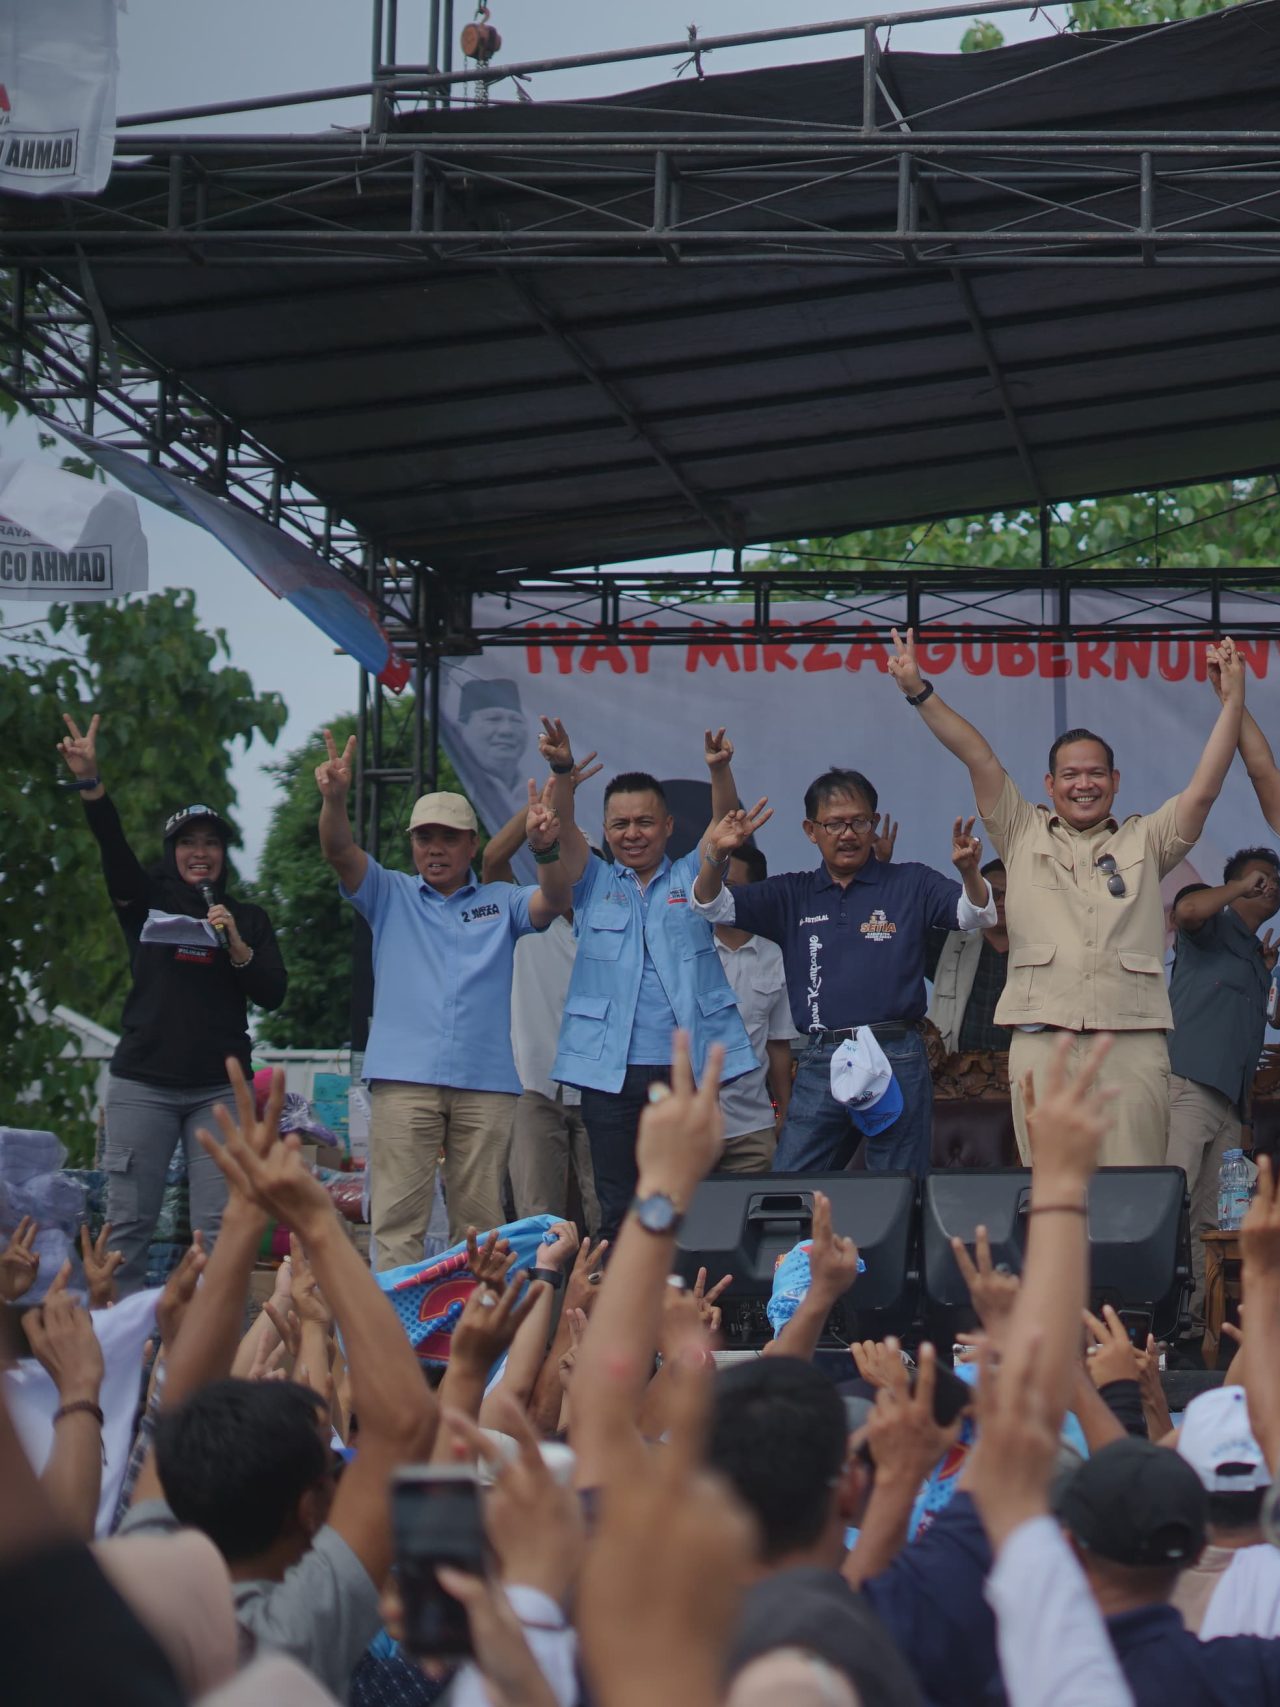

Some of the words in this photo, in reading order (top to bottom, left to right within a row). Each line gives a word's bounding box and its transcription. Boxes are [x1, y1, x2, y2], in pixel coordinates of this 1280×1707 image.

[5, 138, 72, 169] AHMAD
[31, 551, 105, 582] AHMAD
[525, 620, 658, 674] IYAY
[685, 620, 889, 674] MIRZA
[461, 911, 471, 923] 2
[860, 922, 897, 933] SETIA
